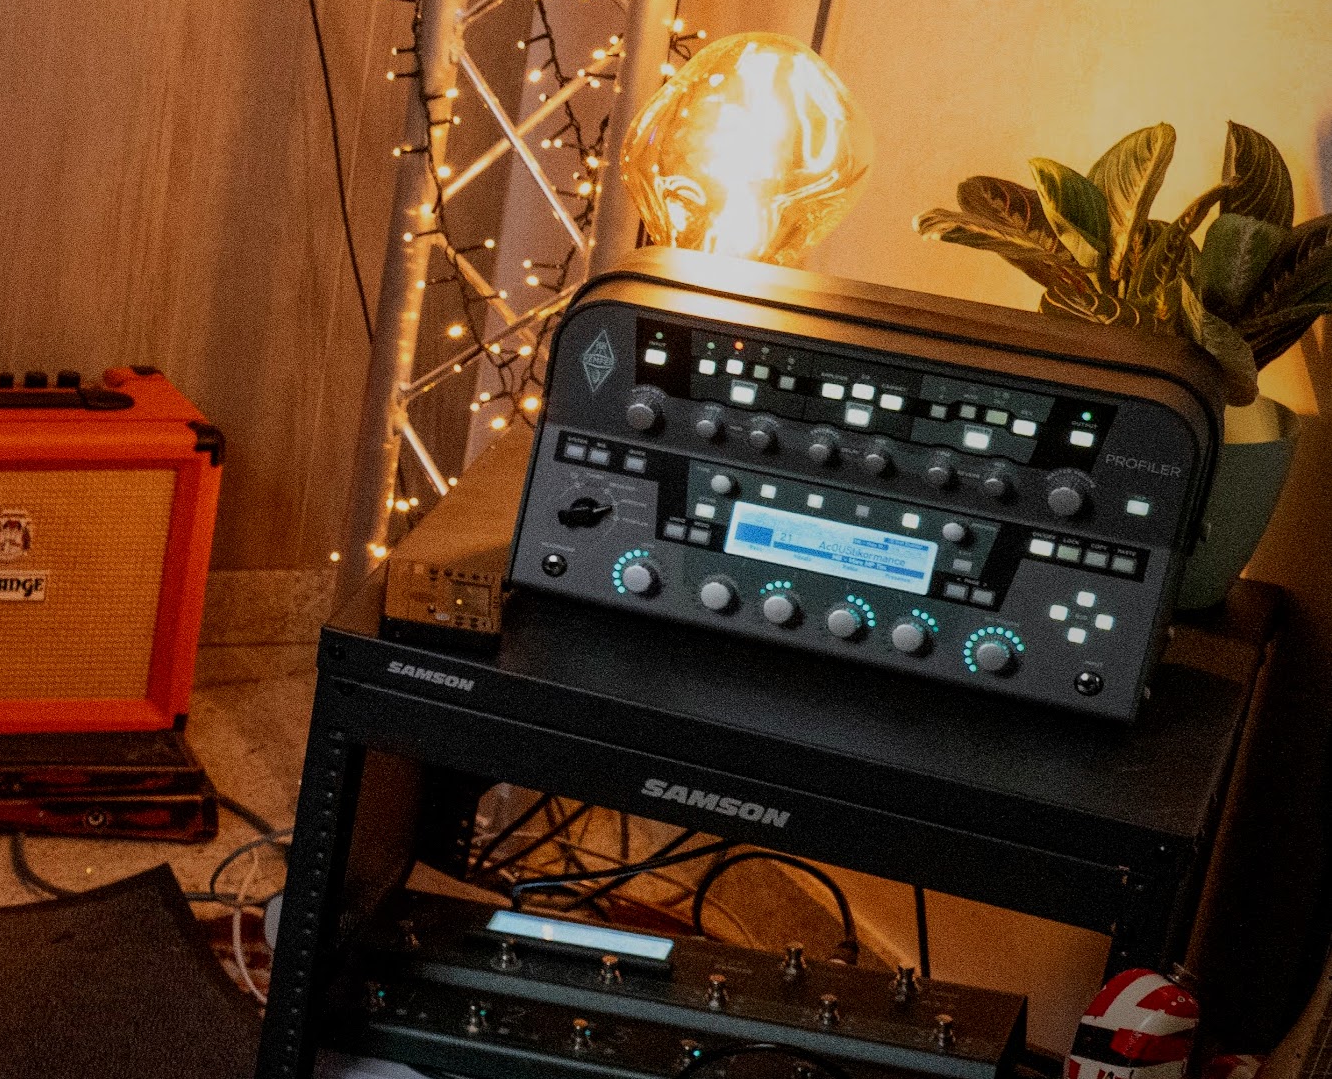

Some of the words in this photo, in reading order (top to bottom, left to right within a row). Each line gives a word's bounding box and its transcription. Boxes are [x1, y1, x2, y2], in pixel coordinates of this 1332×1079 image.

[1104, 452, 1182, 478] PROFILER
[386, 660, 475, 692] SAMSON
[640, 778, 791, 829] SAMSON
